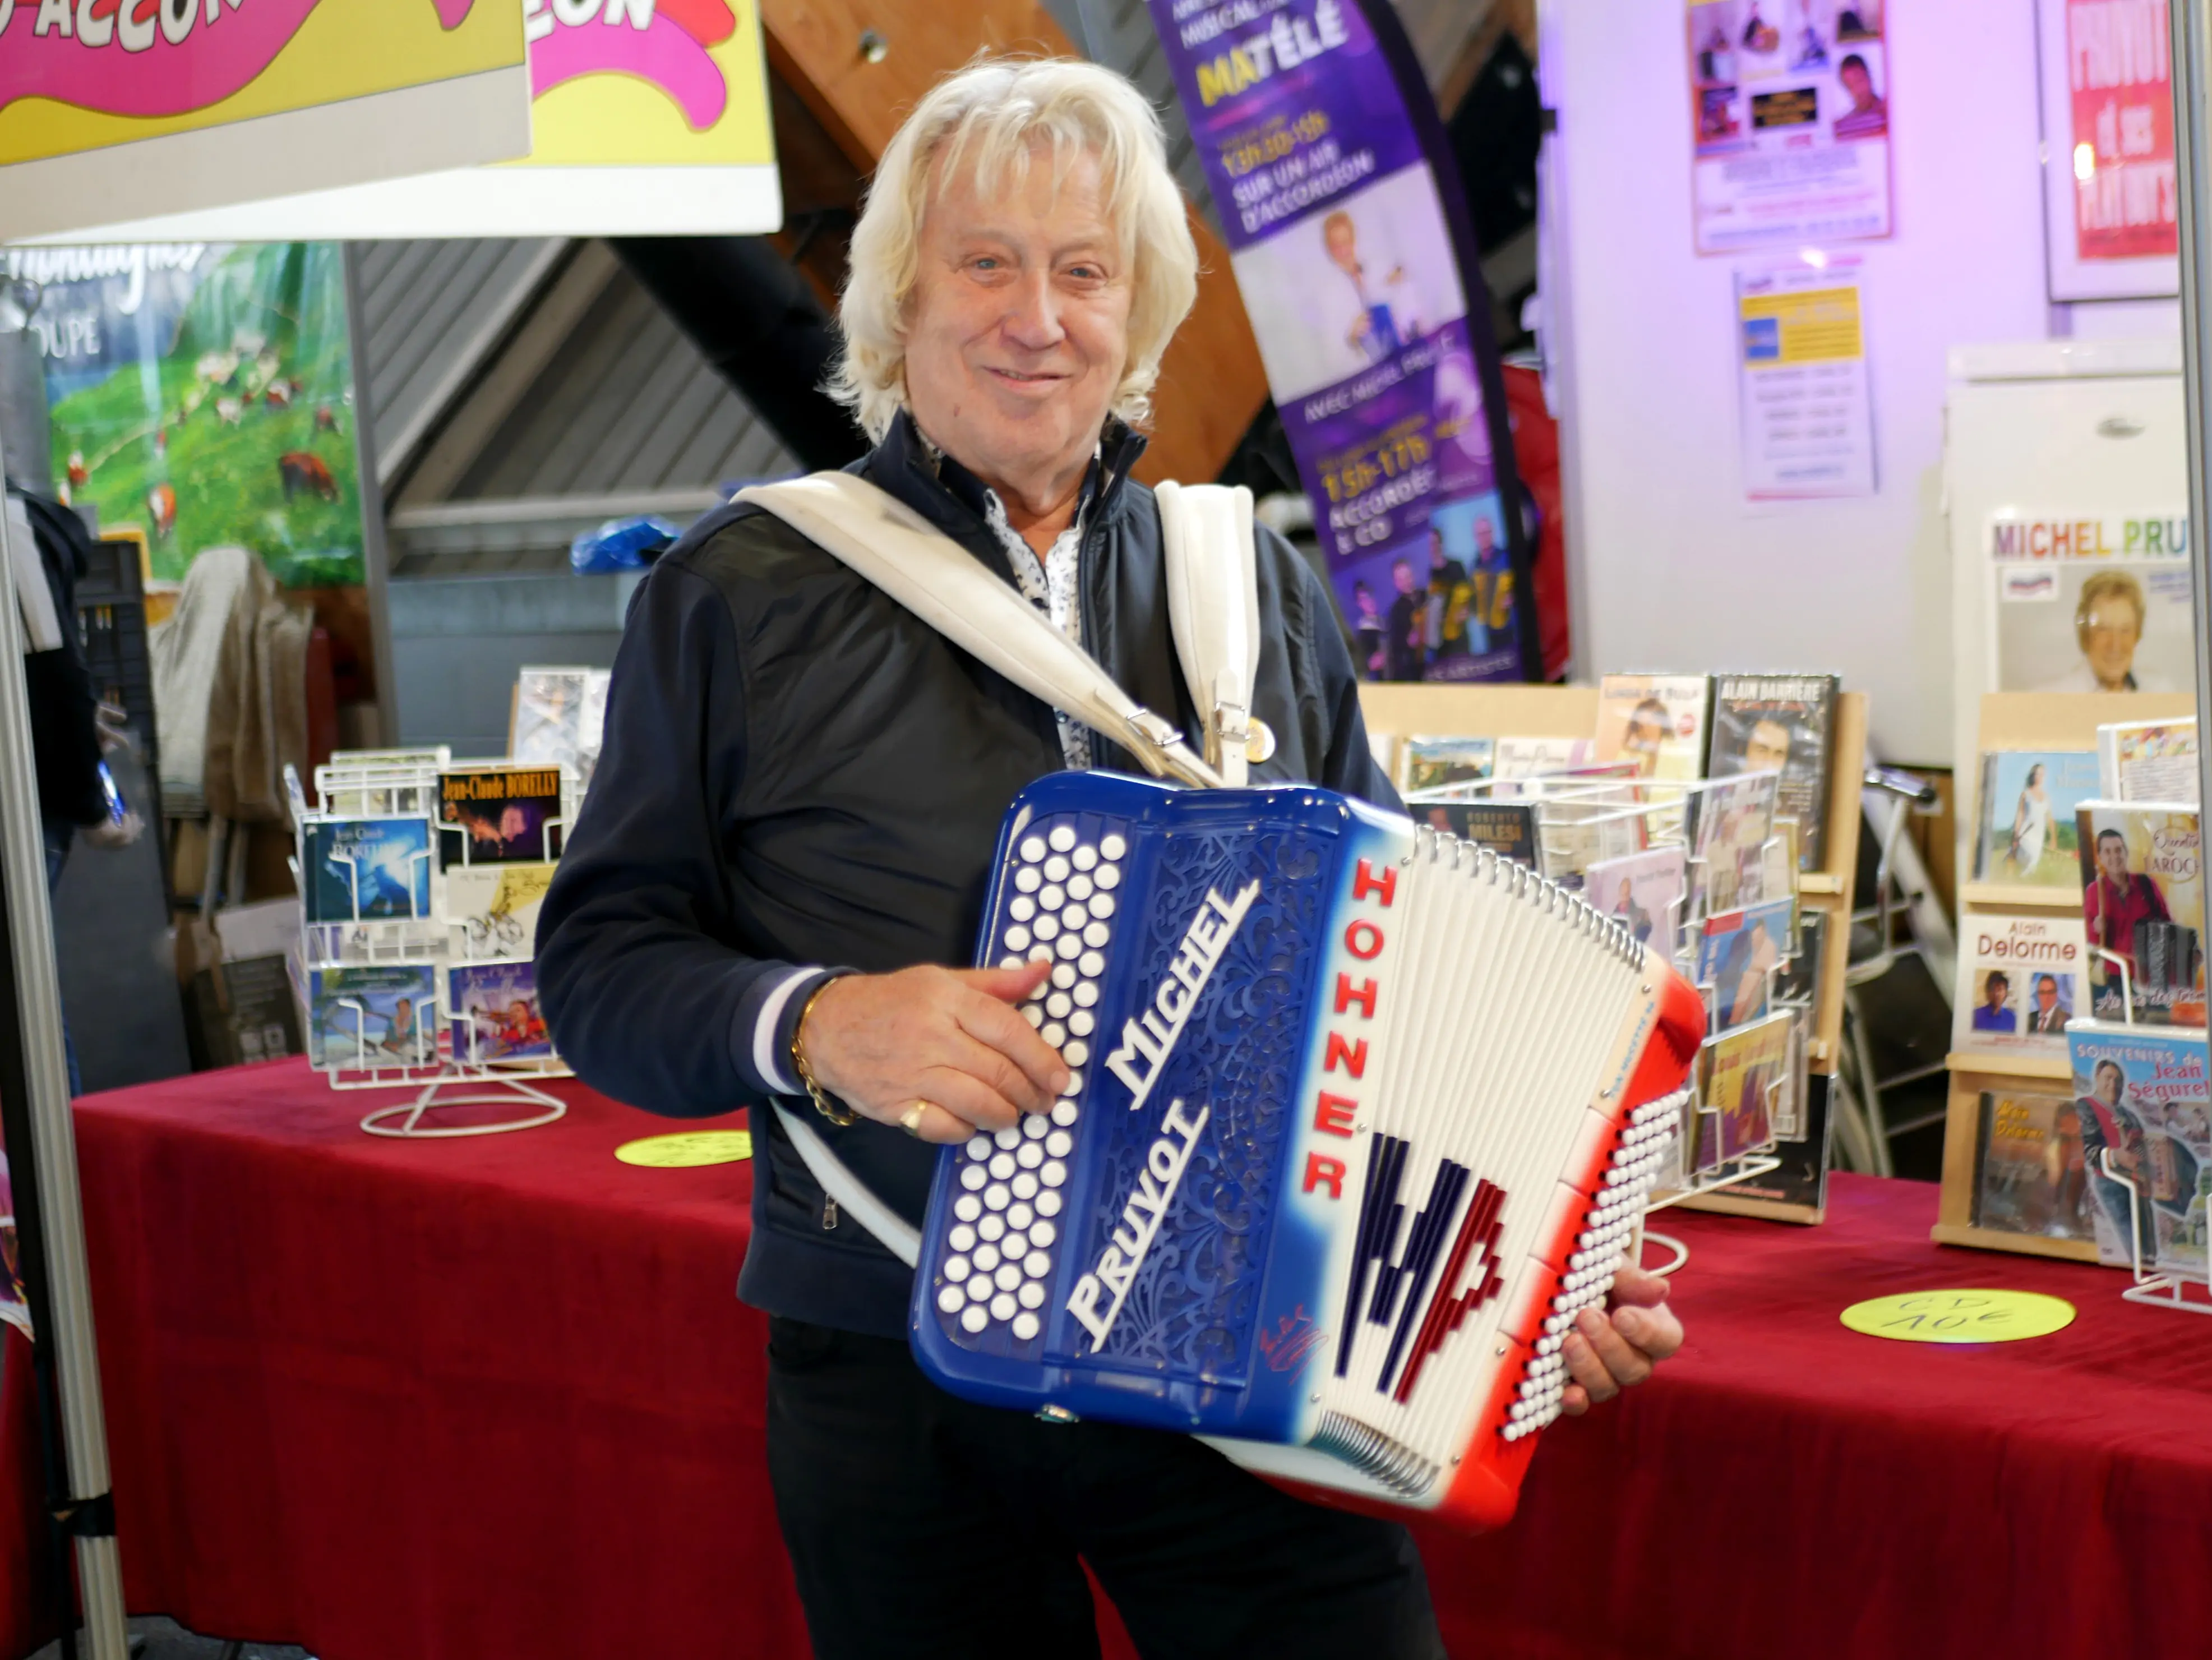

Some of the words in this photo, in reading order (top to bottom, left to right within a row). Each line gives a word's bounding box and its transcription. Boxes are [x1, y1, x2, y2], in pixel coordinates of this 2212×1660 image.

[1993, 520, 2112, 560] MICHEL
[1721, 680, 1758, 700] ALAIN
[443, 776, 504, 800] Jean-Claude
[2008, 922, 2046, 935] Alain
[1978, 934, 2077, 960] Delorme
[1105, 878, 1261, 1110] MICHEL
[1302, 857, 1397, 1201] HOHNER
[2076, 1043, 2176, 1064] SOUVENIRS
[2182, 1052, 2203, 1066] de
[2151, 1060, 2202, 1080] Jean
[2128, 1080, 2210, 1103] Ségurel
[1066, 1098, 1211, 1353] PRUVOT
[1898, 1297, 1993, 1311] CD
